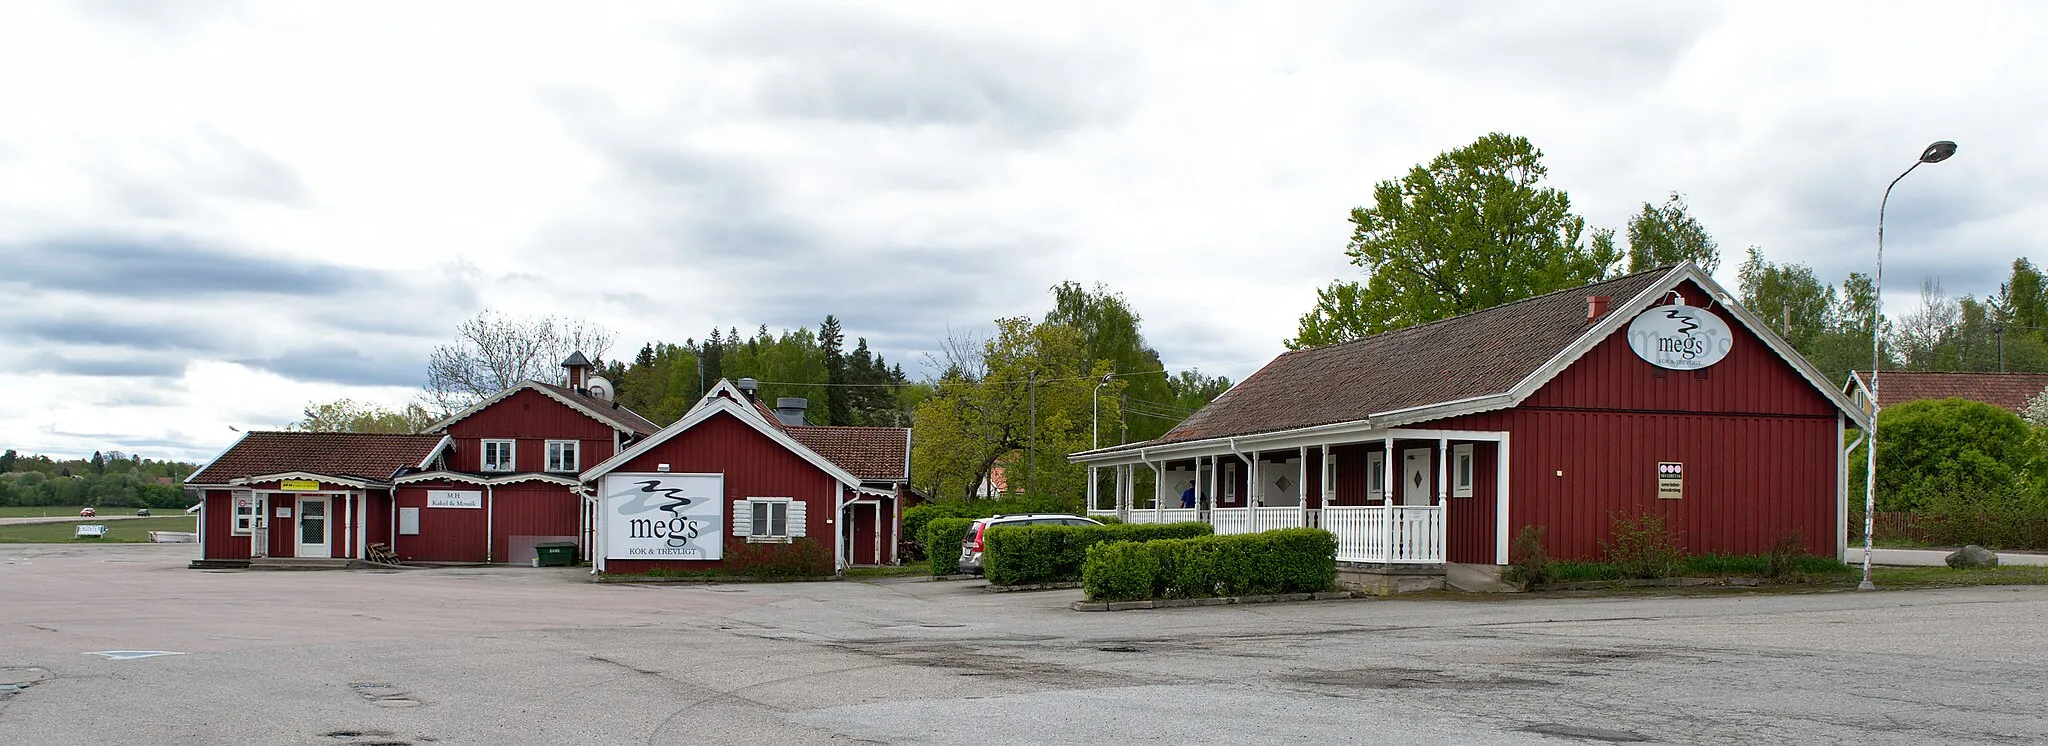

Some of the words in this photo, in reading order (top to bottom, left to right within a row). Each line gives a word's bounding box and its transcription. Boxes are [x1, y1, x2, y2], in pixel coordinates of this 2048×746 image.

[1659, 336, 1703, 359] megs
[629, 516, 699, 548] megs
[629, 547, 647, 555] KÖK
